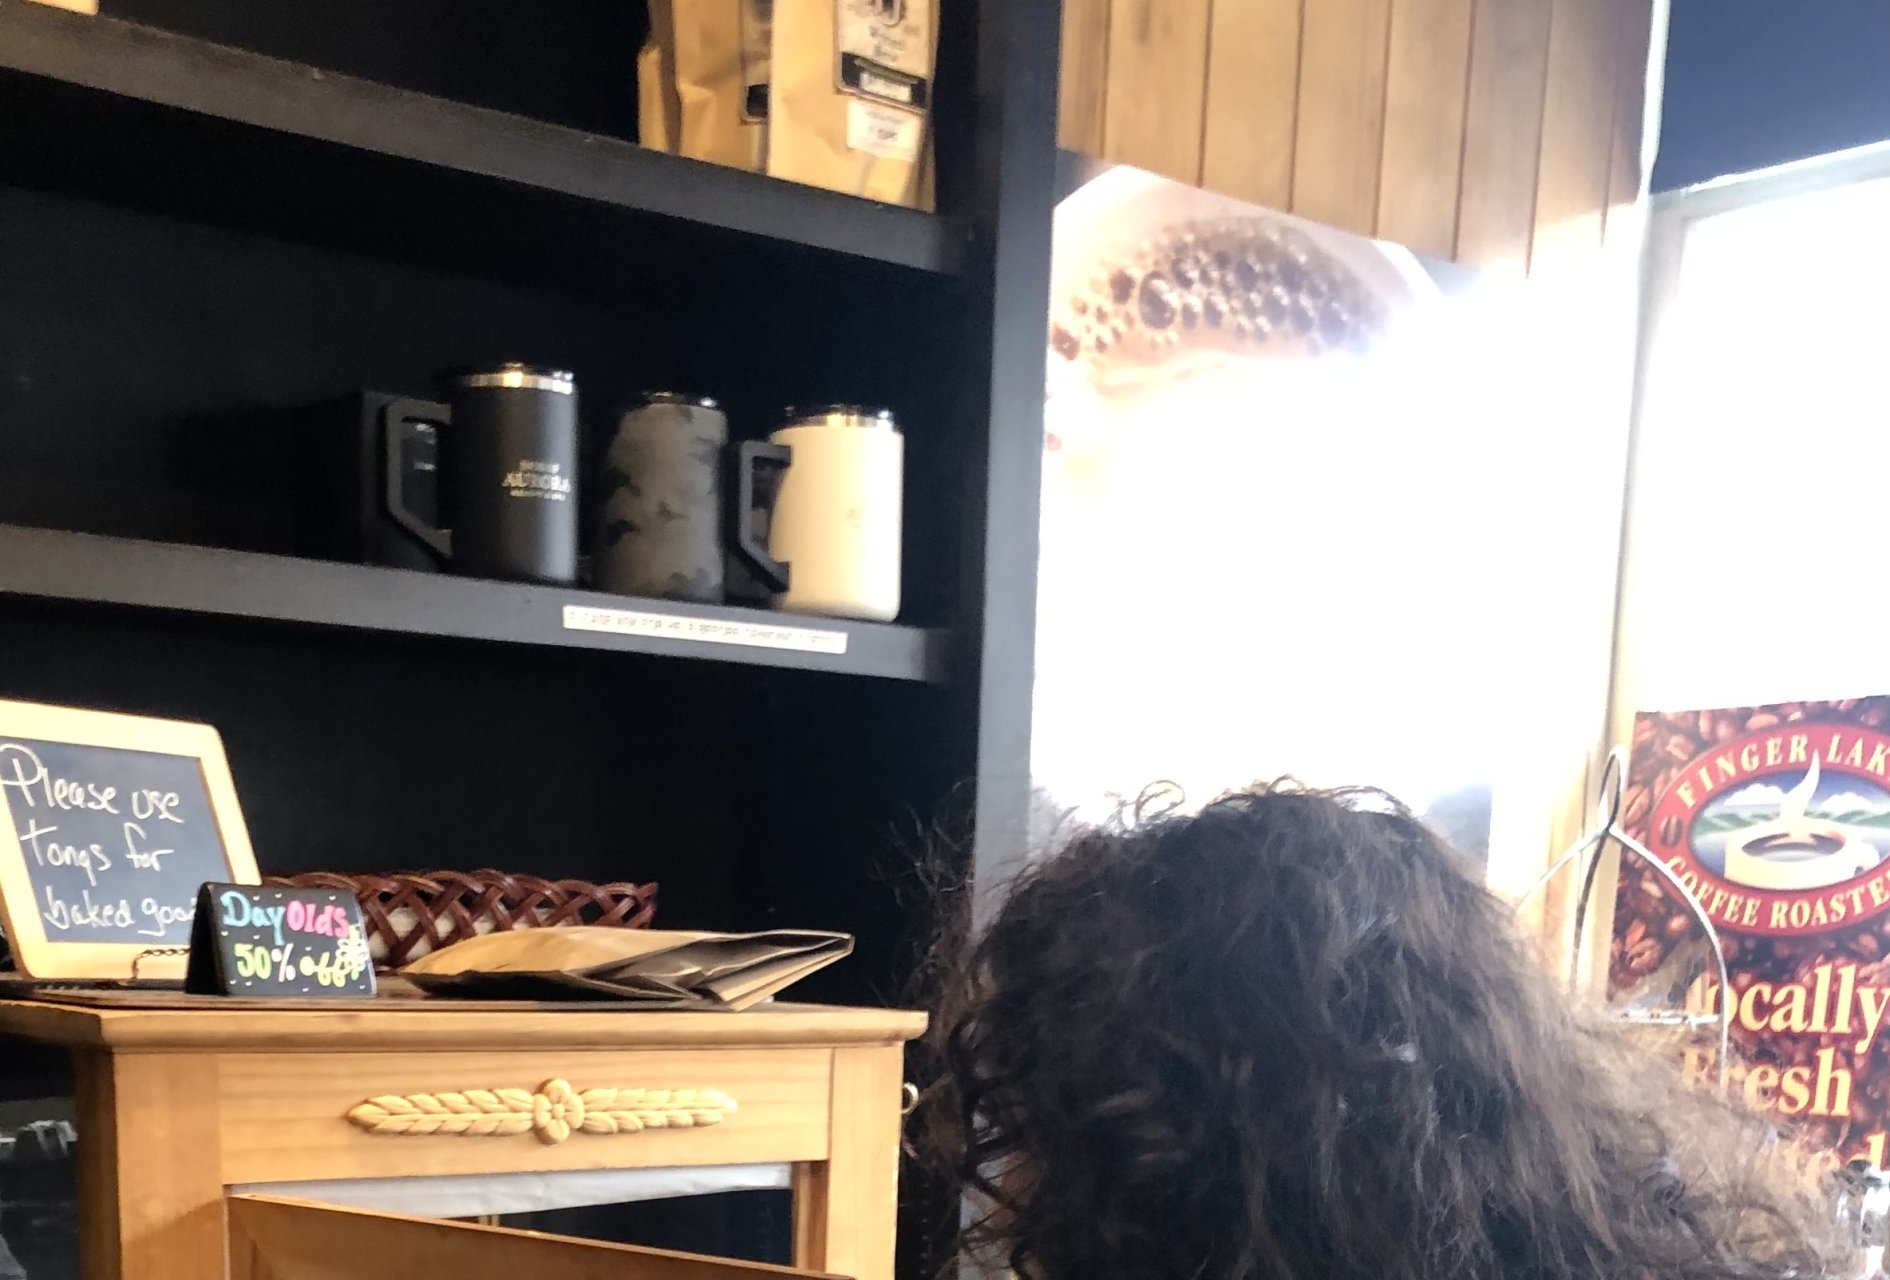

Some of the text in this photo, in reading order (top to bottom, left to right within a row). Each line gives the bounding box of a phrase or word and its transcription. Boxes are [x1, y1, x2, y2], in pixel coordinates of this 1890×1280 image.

[0, 743, 184, 824] Please use
[1676, 733, 1890, 810] FINGER LAK
[123, 821, 175, 872] for
[43, 885, 136, 930] baked
[220, 890, 286, 947] Day
[1664, 855, 1890, 929] COFFEE ROASTE
[233, 942, 297, 983] 50%
